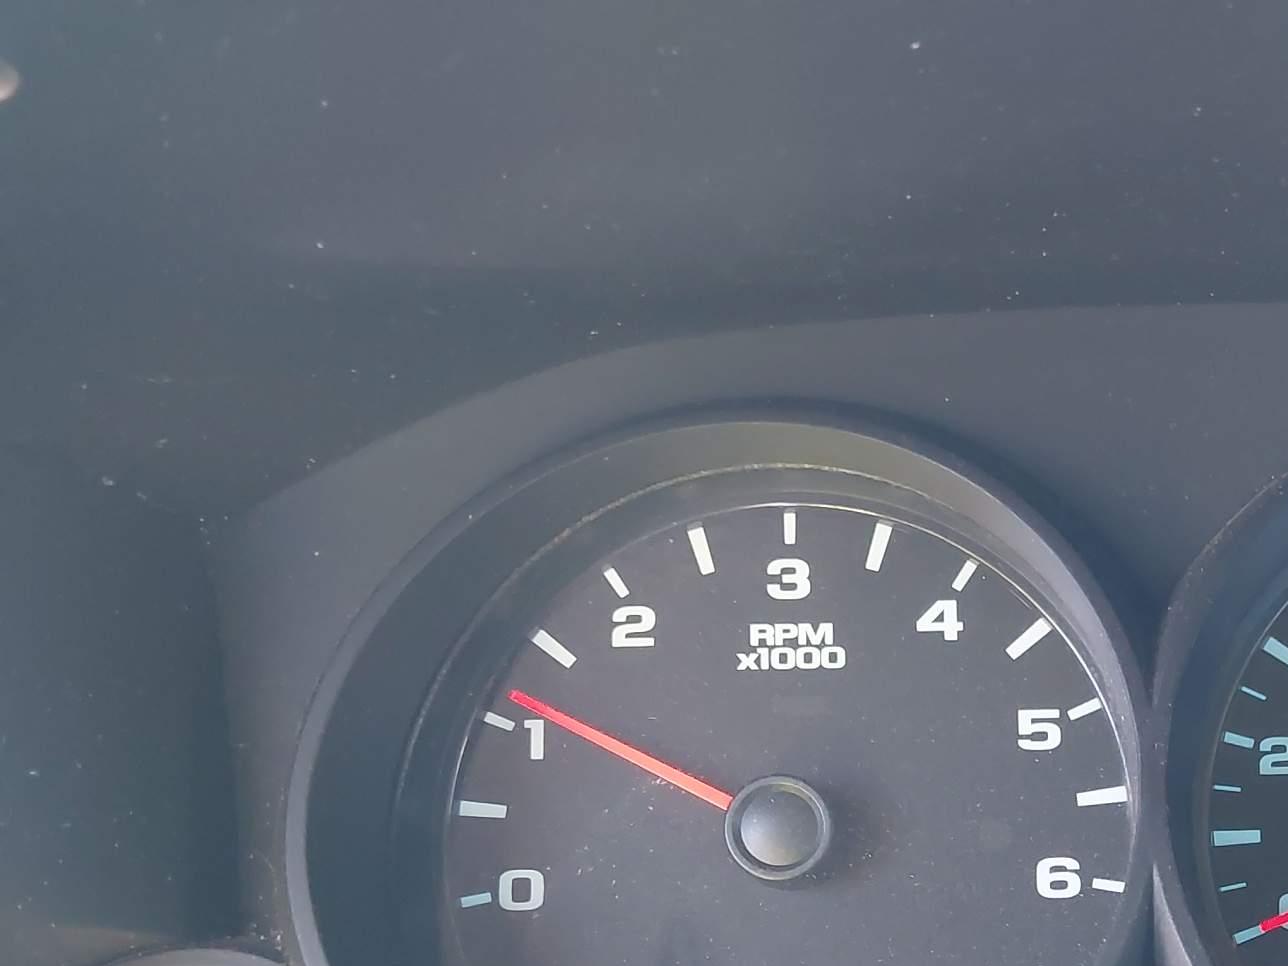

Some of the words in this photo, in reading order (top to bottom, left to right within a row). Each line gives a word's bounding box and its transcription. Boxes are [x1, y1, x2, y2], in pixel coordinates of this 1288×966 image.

[767, 558, 811, 600] 3
[612, 605, 656, 648] 2
[749, 623, 834, 646] RPM
[916, 600, 963, 641] 4
[736, 647, 846, 670] x1000
[524, 719, 545, 760] 1
[1017, 708, 1061, 751] 5
[498, 869, 545, 911] 0
[1035, 857, 1082, 899] 6
